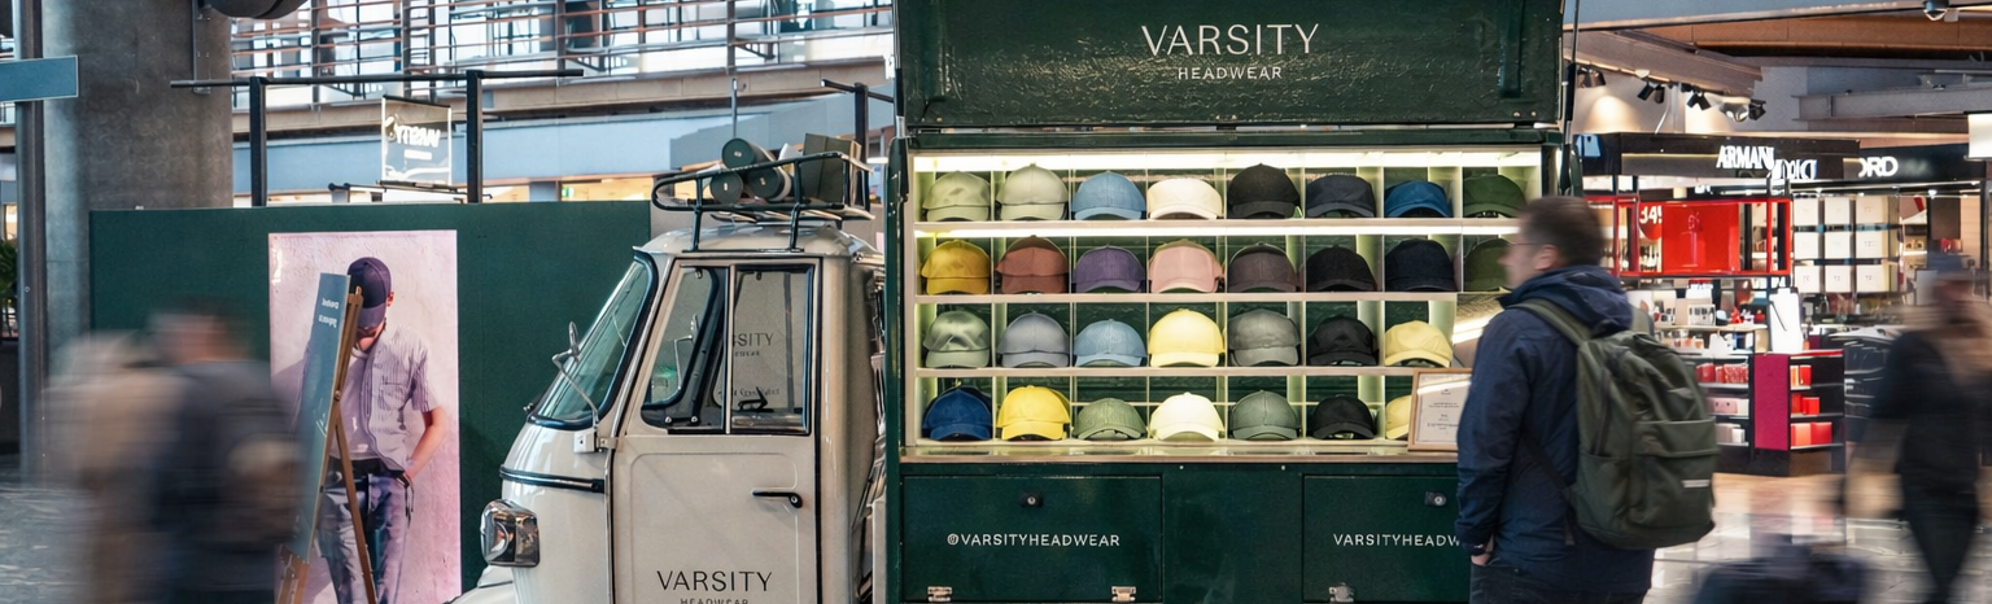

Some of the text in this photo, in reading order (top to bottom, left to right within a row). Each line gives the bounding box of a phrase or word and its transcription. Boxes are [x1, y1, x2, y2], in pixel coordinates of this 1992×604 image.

[1141, 23, 1319, 56] VARSITY
[1178, 66, 1282, 80] HEADWEAR
[947, 533, 1120, 547] @VARSITYHEADWEAR
[656, 570, 773, 592] VARSITY
